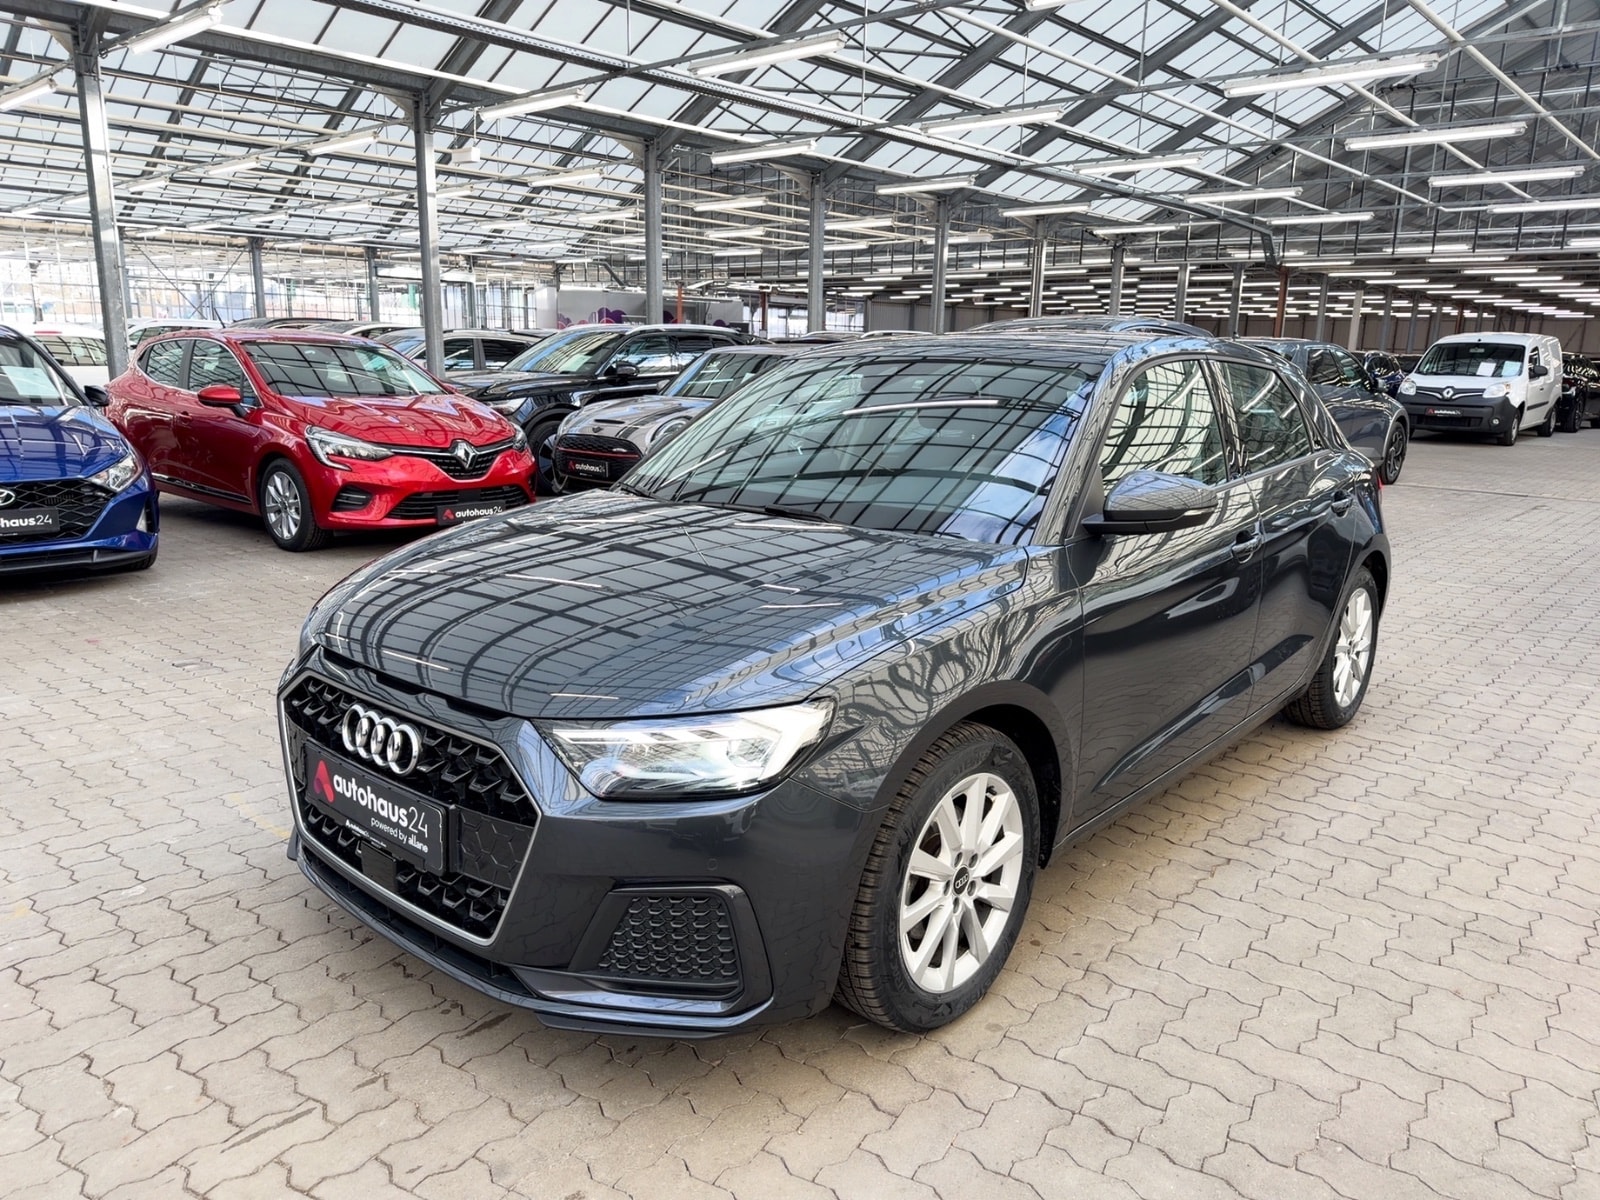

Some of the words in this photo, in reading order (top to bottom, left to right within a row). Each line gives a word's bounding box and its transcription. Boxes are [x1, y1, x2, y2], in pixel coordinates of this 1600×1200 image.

[0, 514, 52, 528] haus24
[455, 506, 503, 518] autohaus24
[333, 774, 428, 838] autohaus24
[371, 817, 398, 838] powered
[398, 829, 407, 845] by
[408, 834, 428, 853] allane
